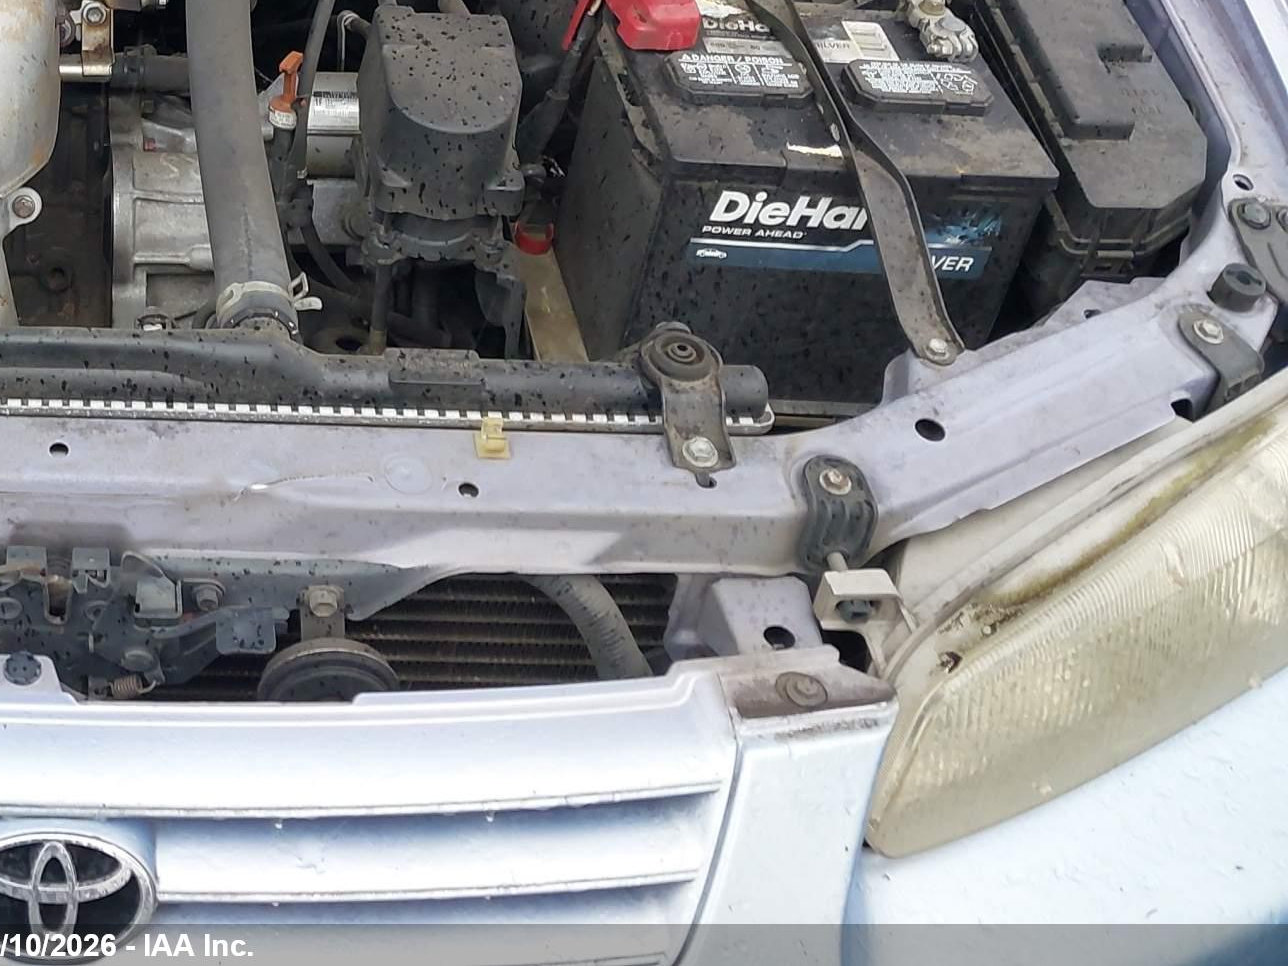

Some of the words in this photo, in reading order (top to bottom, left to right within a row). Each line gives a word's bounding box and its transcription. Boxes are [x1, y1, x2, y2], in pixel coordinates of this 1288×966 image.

[702, 17, 770, 32] DieHa
[691, 54, 735, 64] DANGER
[744, 55, 784, 65] POISON
[709, 190, 867, 231] DieHar
[701, 225, 752, 237] POWER
[754, 229, 804, 240] AHEAD
[930, 255, 975, 273] VER
